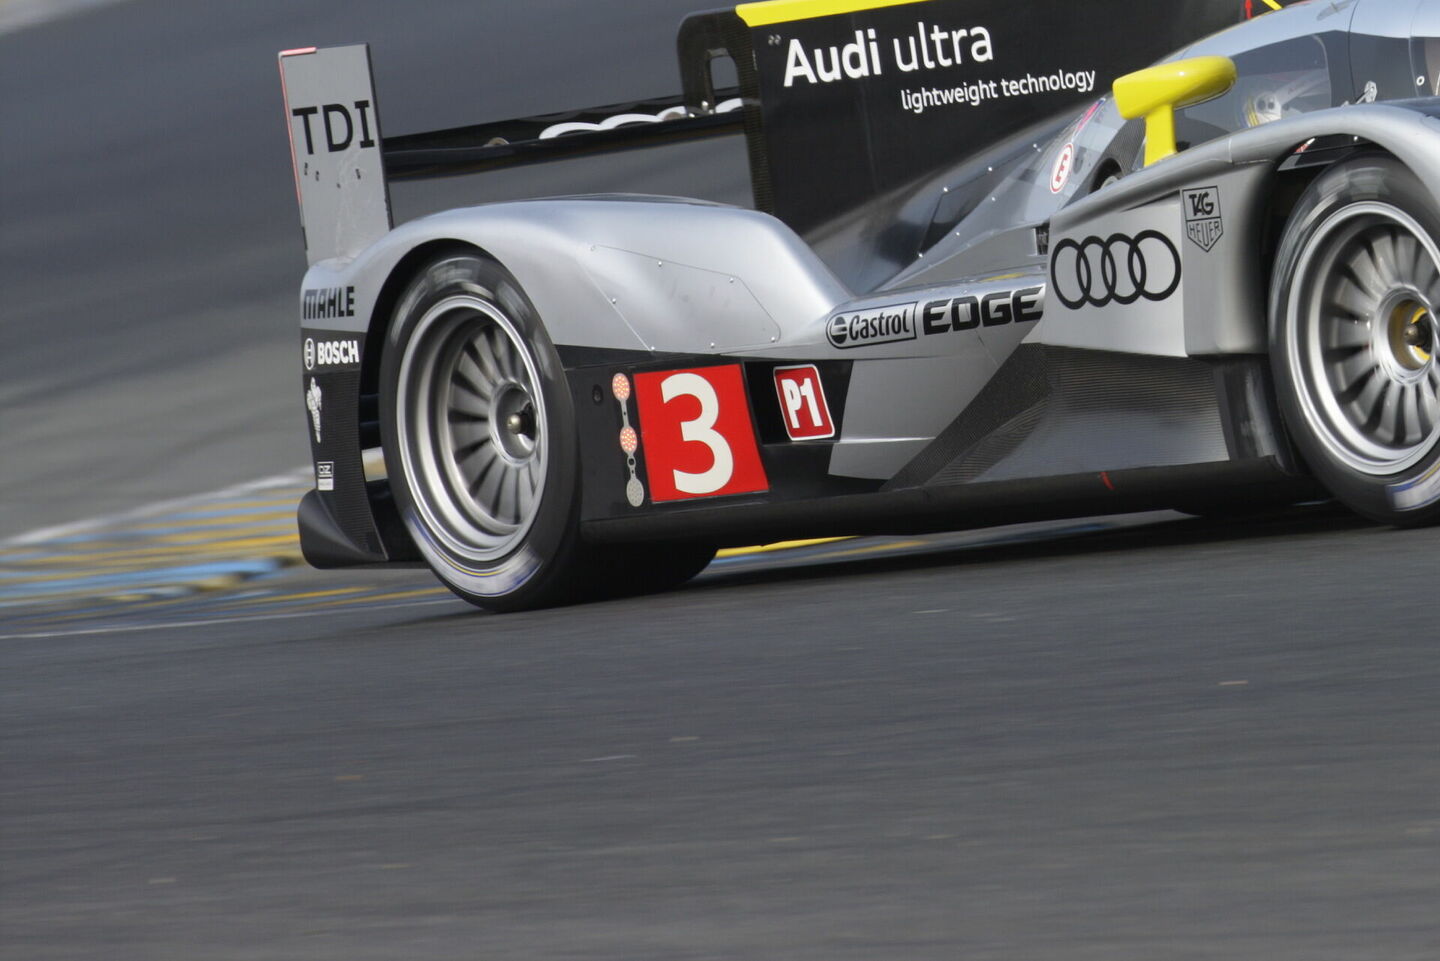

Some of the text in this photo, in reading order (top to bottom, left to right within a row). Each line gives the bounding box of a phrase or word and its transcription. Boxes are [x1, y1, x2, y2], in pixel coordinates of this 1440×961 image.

[783, 21, 993, 87] Audi ultra
[901, 69, 1096, 114] lightweight technology
[292, 100, 375, 155] TDI
[1188, 192, 1214, 216] TAG
[1189, 221, 1221, 247] HEUER
[303, 286, 355, 320] MAHLE
[850, 286, 1044, 341] Castrol EDGE
[317, 340, 360, 365] BOSCH
[781, 378, 824, 429] P1
[660, 373, 734, 494] 3
